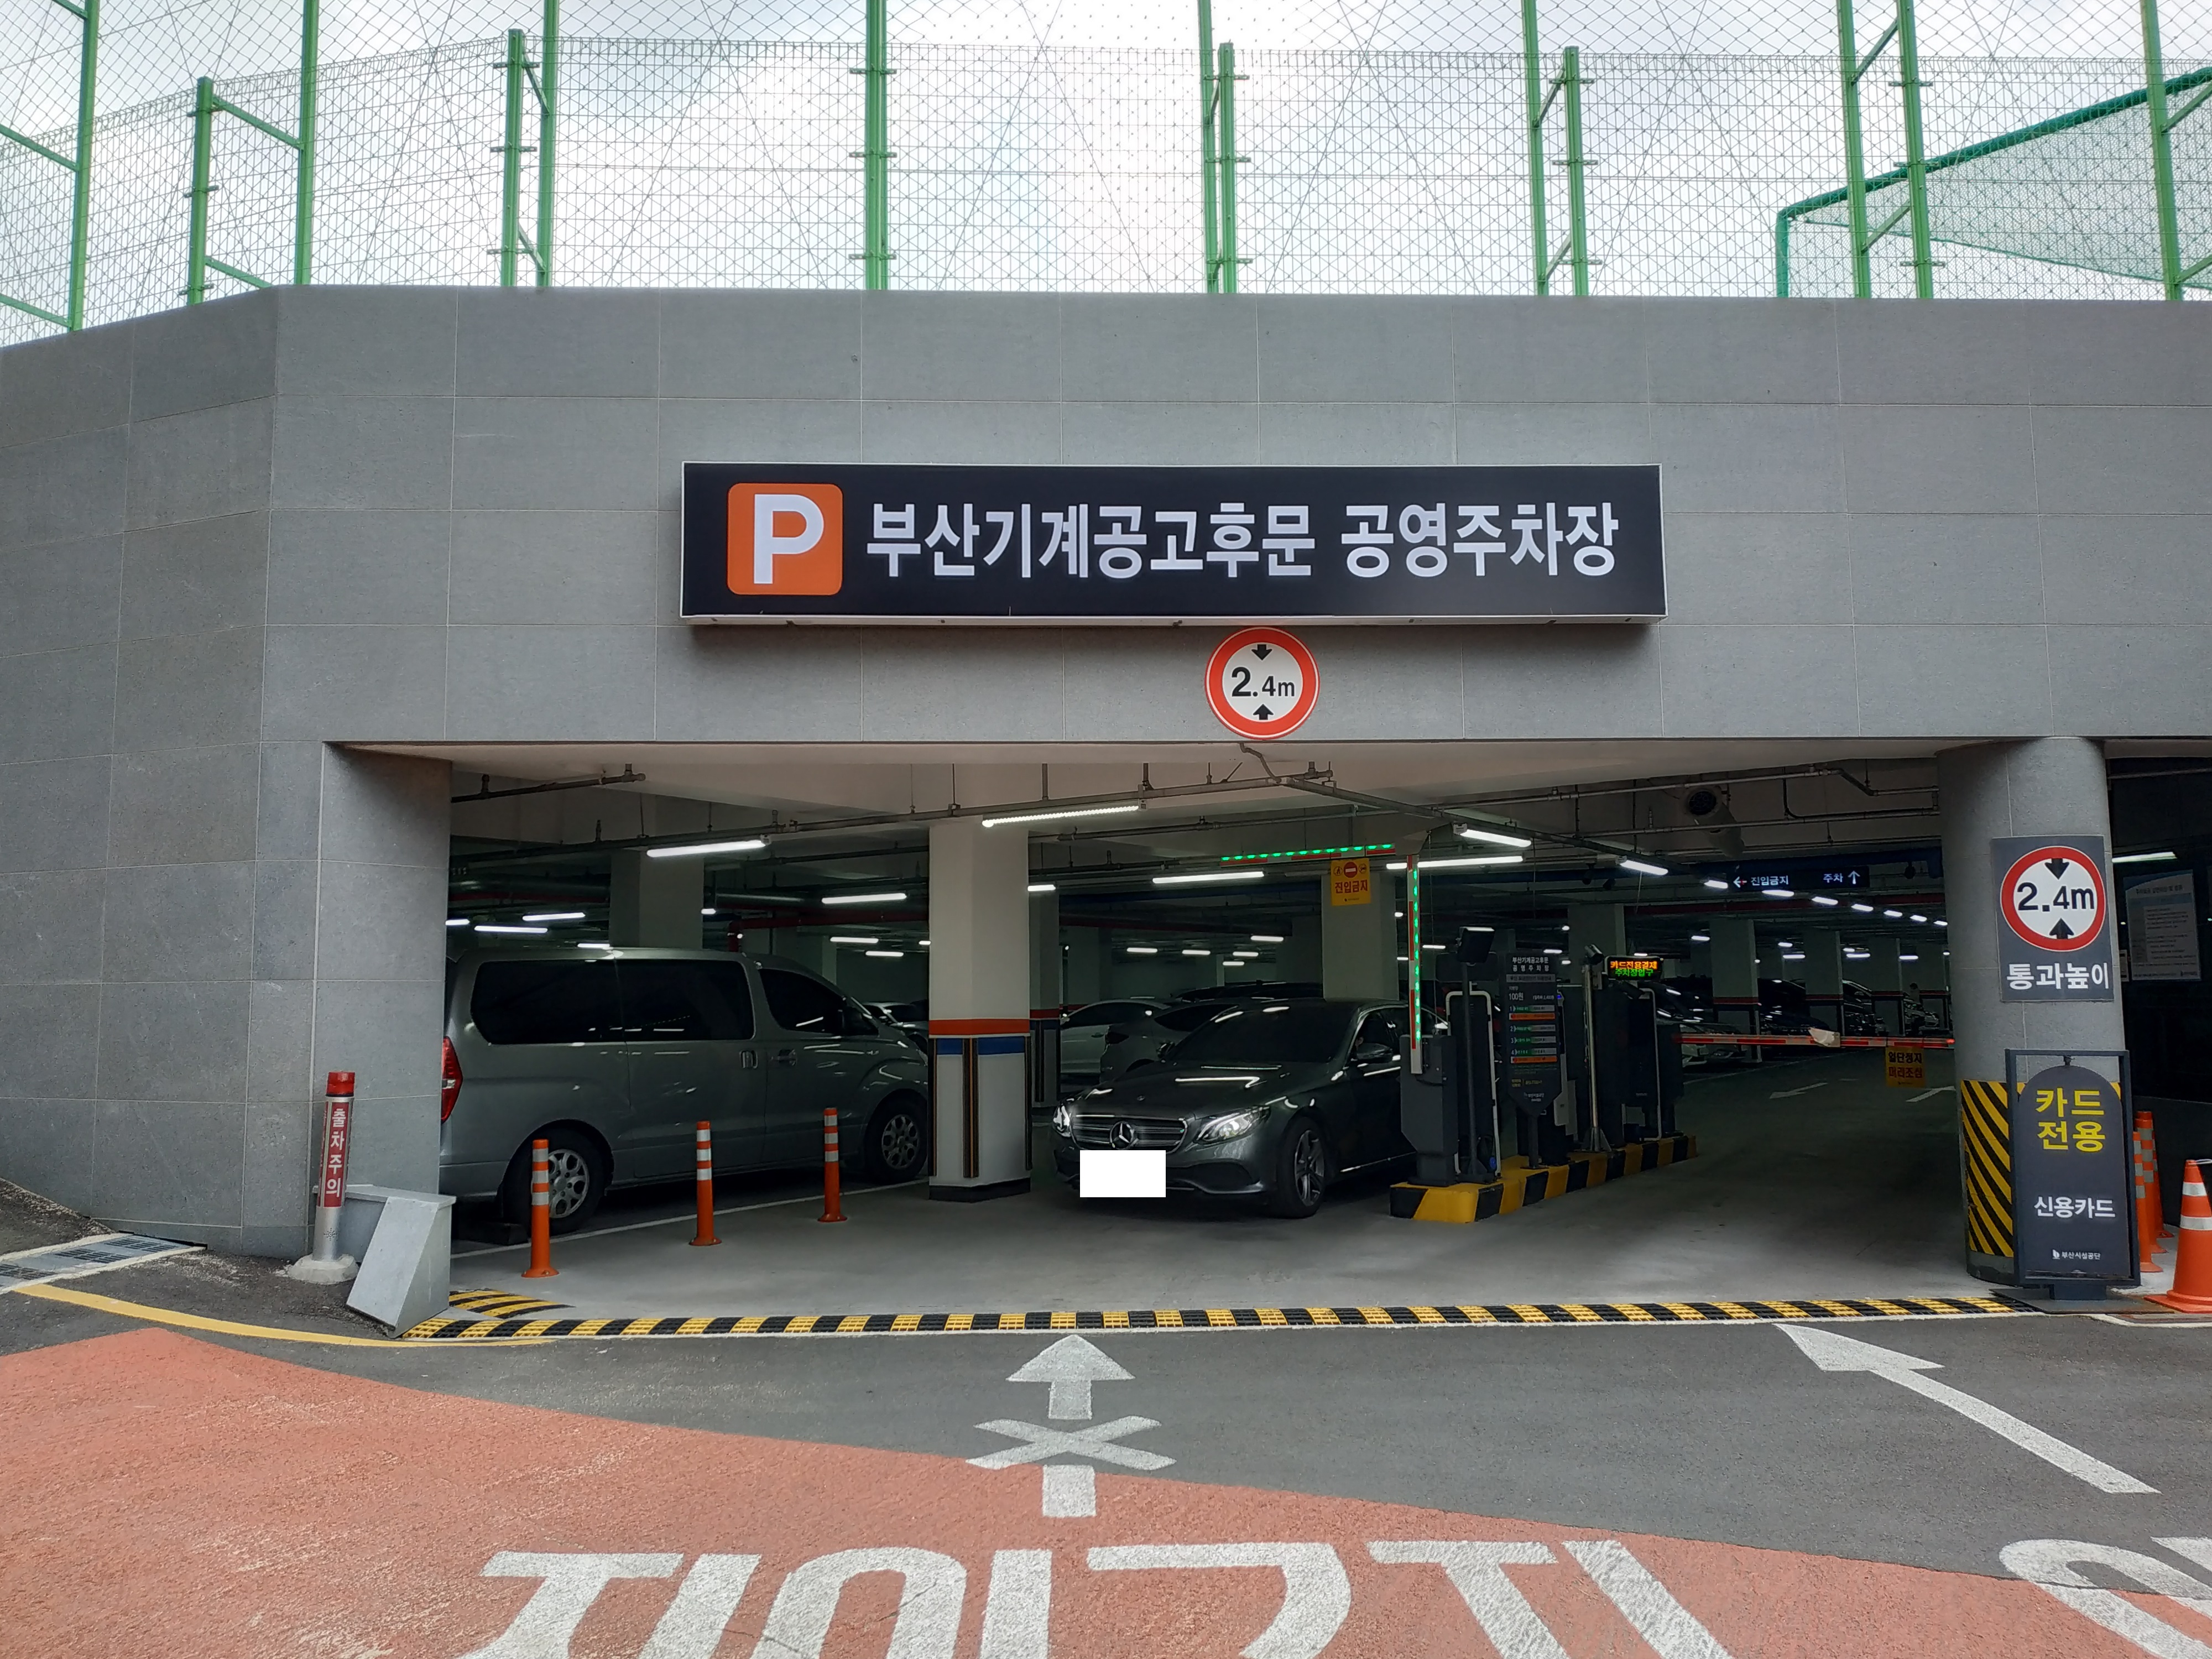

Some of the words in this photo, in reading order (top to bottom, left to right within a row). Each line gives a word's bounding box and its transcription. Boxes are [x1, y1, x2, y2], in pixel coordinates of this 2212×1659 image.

[753, 494, 825, 585] P
[867, 502, 1316, 578] 부산기계공고후문
[1341, 502, 1619, 577] 공영주차장
[1231, 666, 1295, 697] 2.4m
[1335, 879, 1368, 894] 진입금지
[1750, 875, 1789, 886] 진입금지
[1823, 873, 1843, 883] 주차
[2017, 882, 2095, 912] 2.4m
[1610, 961, 1657, 969] 카드전용결제
[2006, 963, 2109, 990] 통과높이
[1888, 1051, 1922, 1064] 일단정지
[1888, 1066, 1923, 1078] 머리조심
[2035, 1087, 2105, 1118] 카드
[2037, 1121, 2106, 1152] 전용
[326, 1108, 347, 1198] 출차주의
[2033, 1196, 2116, 1219] 신용카드
[2061, 1251, 2101, 1260] 부산시설공단
